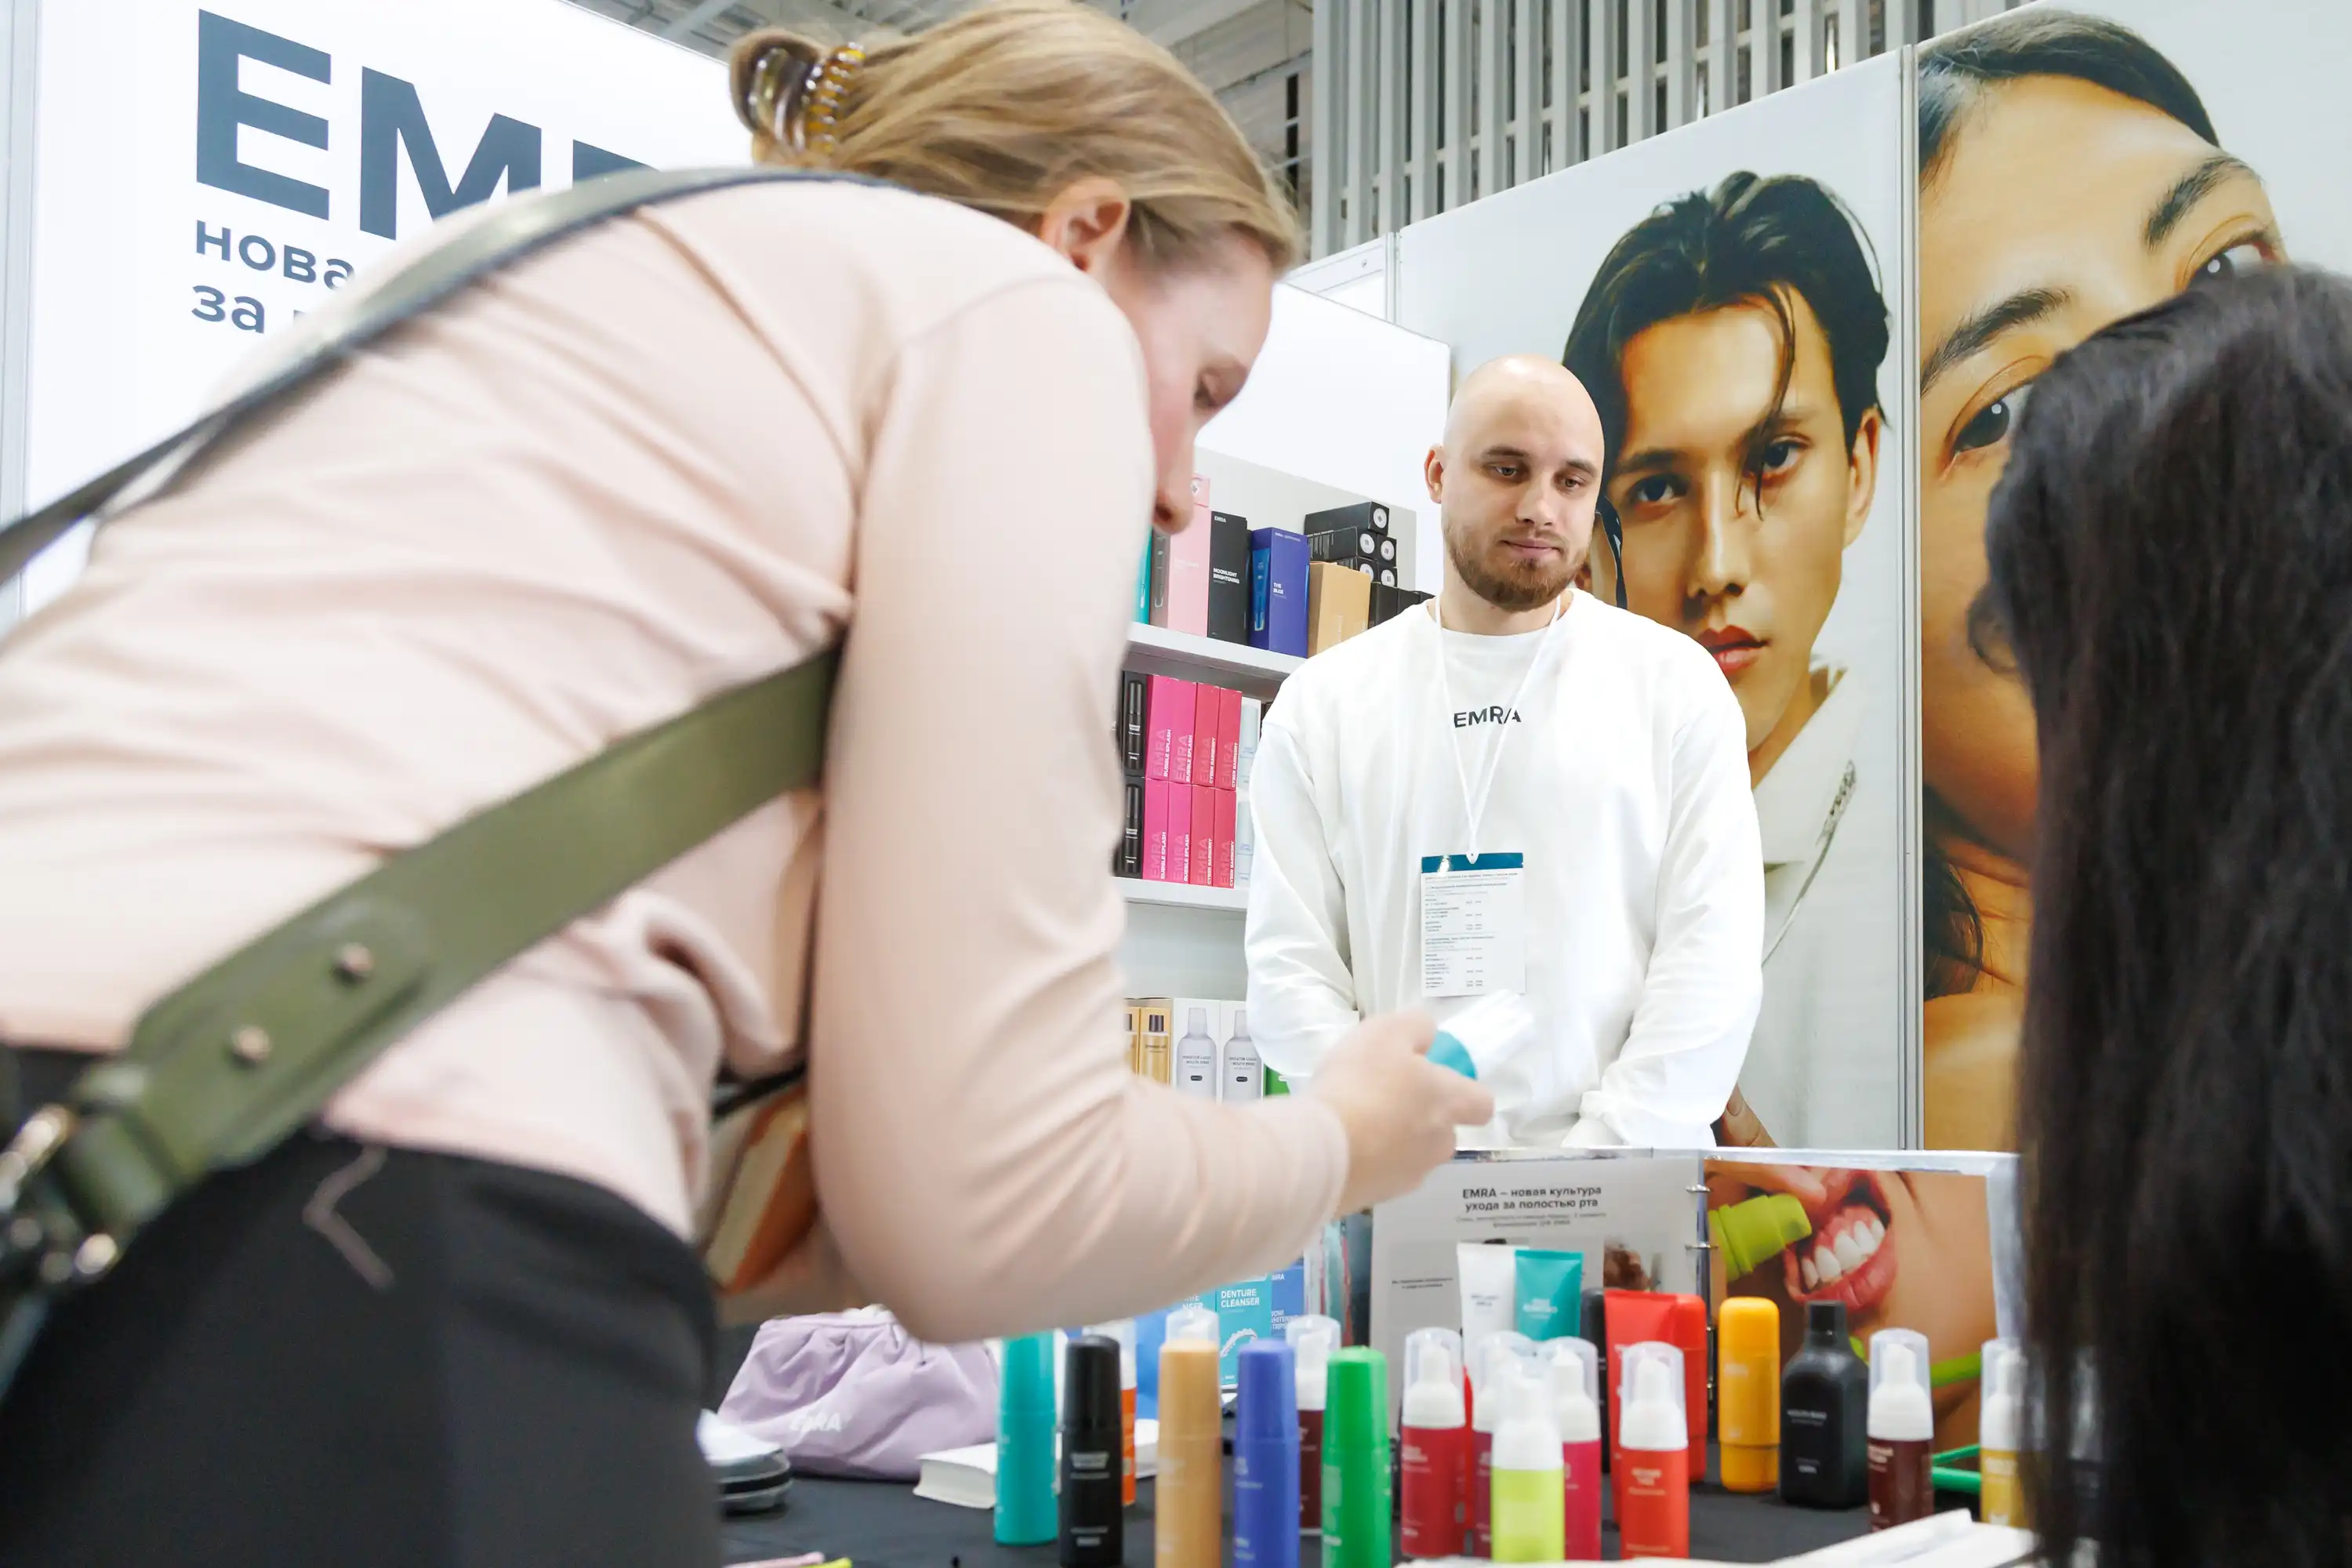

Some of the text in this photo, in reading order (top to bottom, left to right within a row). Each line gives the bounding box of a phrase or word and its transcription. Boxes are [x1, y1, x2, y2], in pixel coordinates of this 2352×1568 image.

[197, 8, 660, 241] EM
[196, 220, 355, 291] нова
[191, 285, 265, 333] за
[1213, 568, 1237, 578] MOONLIGHT
[1213, 573, 1240, 584] BRIGHTENING
[1454, 706, 1522, 728] EMRA
[1462, 1189, 1497, 1199] EMRA
[1511, 1189, 1546, 1197] новая
[1549, 1186, 1602, 1198] культура
[1465, 1197, 1599, 1213] ухода за полостью рта
[1221, 1288, 1257, 1299] DENTURE
[1221, 1298, 1260, 1308] CLEANSER
